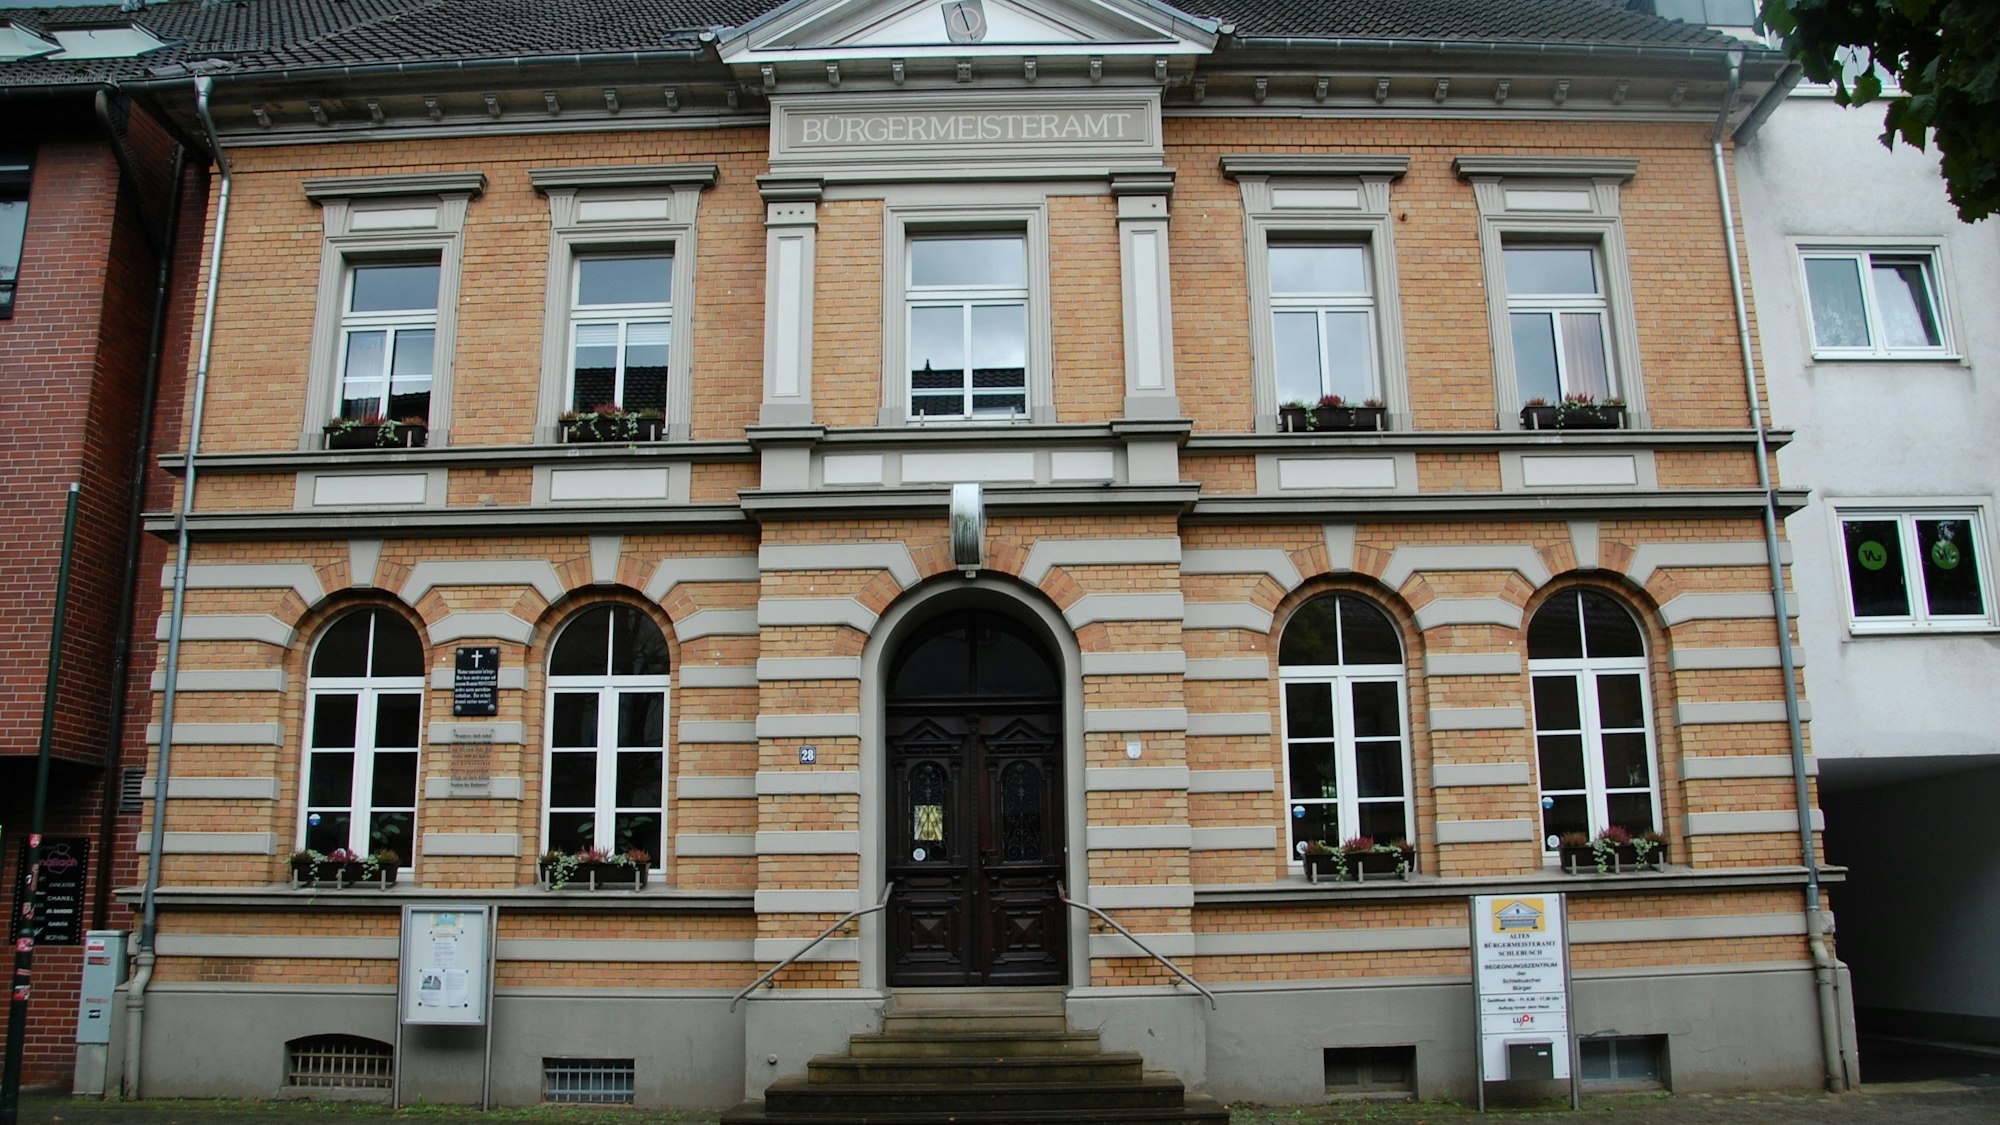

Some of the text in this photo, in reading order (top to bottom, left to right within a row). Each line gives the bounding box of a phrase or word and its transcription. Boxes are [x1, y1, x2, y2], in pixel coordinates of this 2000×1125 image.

[801, 113, 1131, 144] BÜRGERMEISTERAMT
[801, 749, 815, 761] 28
[1484, 962, 1558, 970] BEGEGNUNGSZENTRUM
